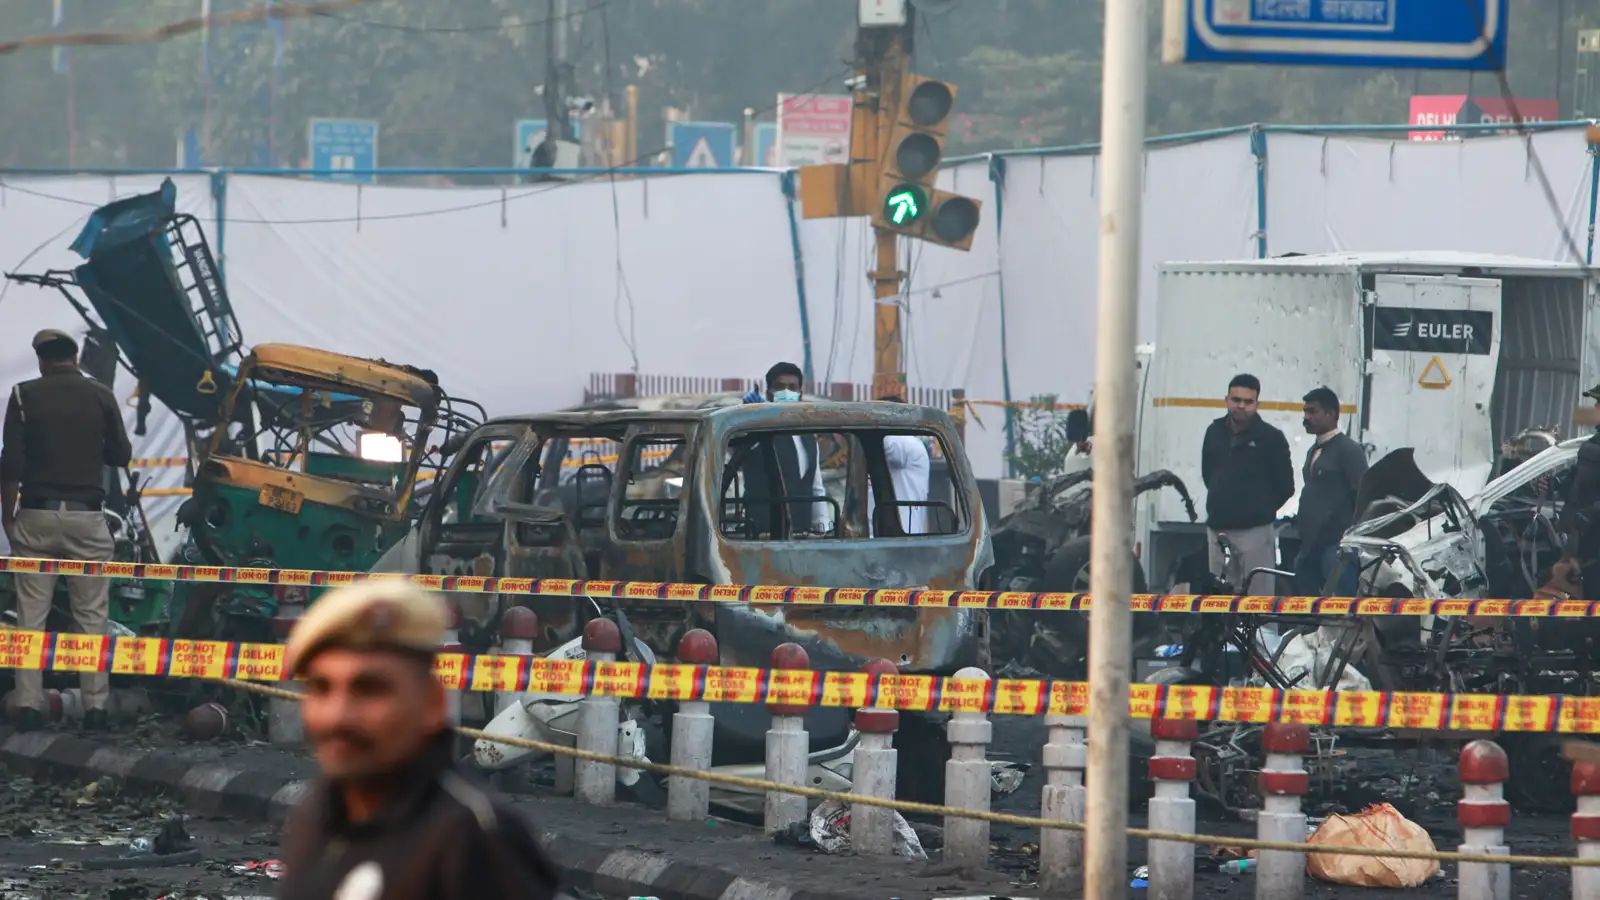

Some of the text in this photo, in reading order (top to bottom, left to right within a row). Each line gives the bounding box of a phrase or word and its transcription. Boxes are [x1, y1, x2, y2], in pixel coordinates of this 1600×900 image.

[1418, 322, 1474, 339] EULER
[501, 583, 517, 591] NOT
[629, 588, 645, 596] NOT
[714, 588, 737, 597] DELHI
[755, 593, 771, 601] NOT
[880, 595, 896, 604] NOT
[10, 634, 33, 645] NOT
[0, 645, 30, 655] ROSS
[60, 640, 94, 651] DELHI
[174, 642, 216, 653] DO NOT
[176, 653, 213, 665] CROSS
[243, 649, 276, 660] DELHI
[56, 655, 96, 666] POLICE
[435, 659, 454, 670] LHI
[533, 660, 573, 671] DO NOT
[182, 665, 207, 676] LINE
[239, 664, 279, 675] POLICE
[600, 667, 631, 677] DELHI
[708, 669, 748, 679] DO NOT
[534, 671, 570, 682] CROSS
[774, 676, 805, 685] DELHI
[540, 682, 565, 692] LINE
[596, 681, 633, 692] POLICE
[710, 680, 745, 690] CROSS
[881, 677, 921, 687] DO NOT
[883, 687, 917, 697] CROSS
[946, 683, 978, 692] DELHI
[1053, 684, 1067, 693] DO
[715, 692, 738, 701] LINE
[770, 689, 808, 699] POLICE
[1129, 689, 1149, 699] LHI
[888, 698, 911, 707] LINE
[942, 697, 980, 707] POLICE
[1129, 704, 1152, 714] LICE
